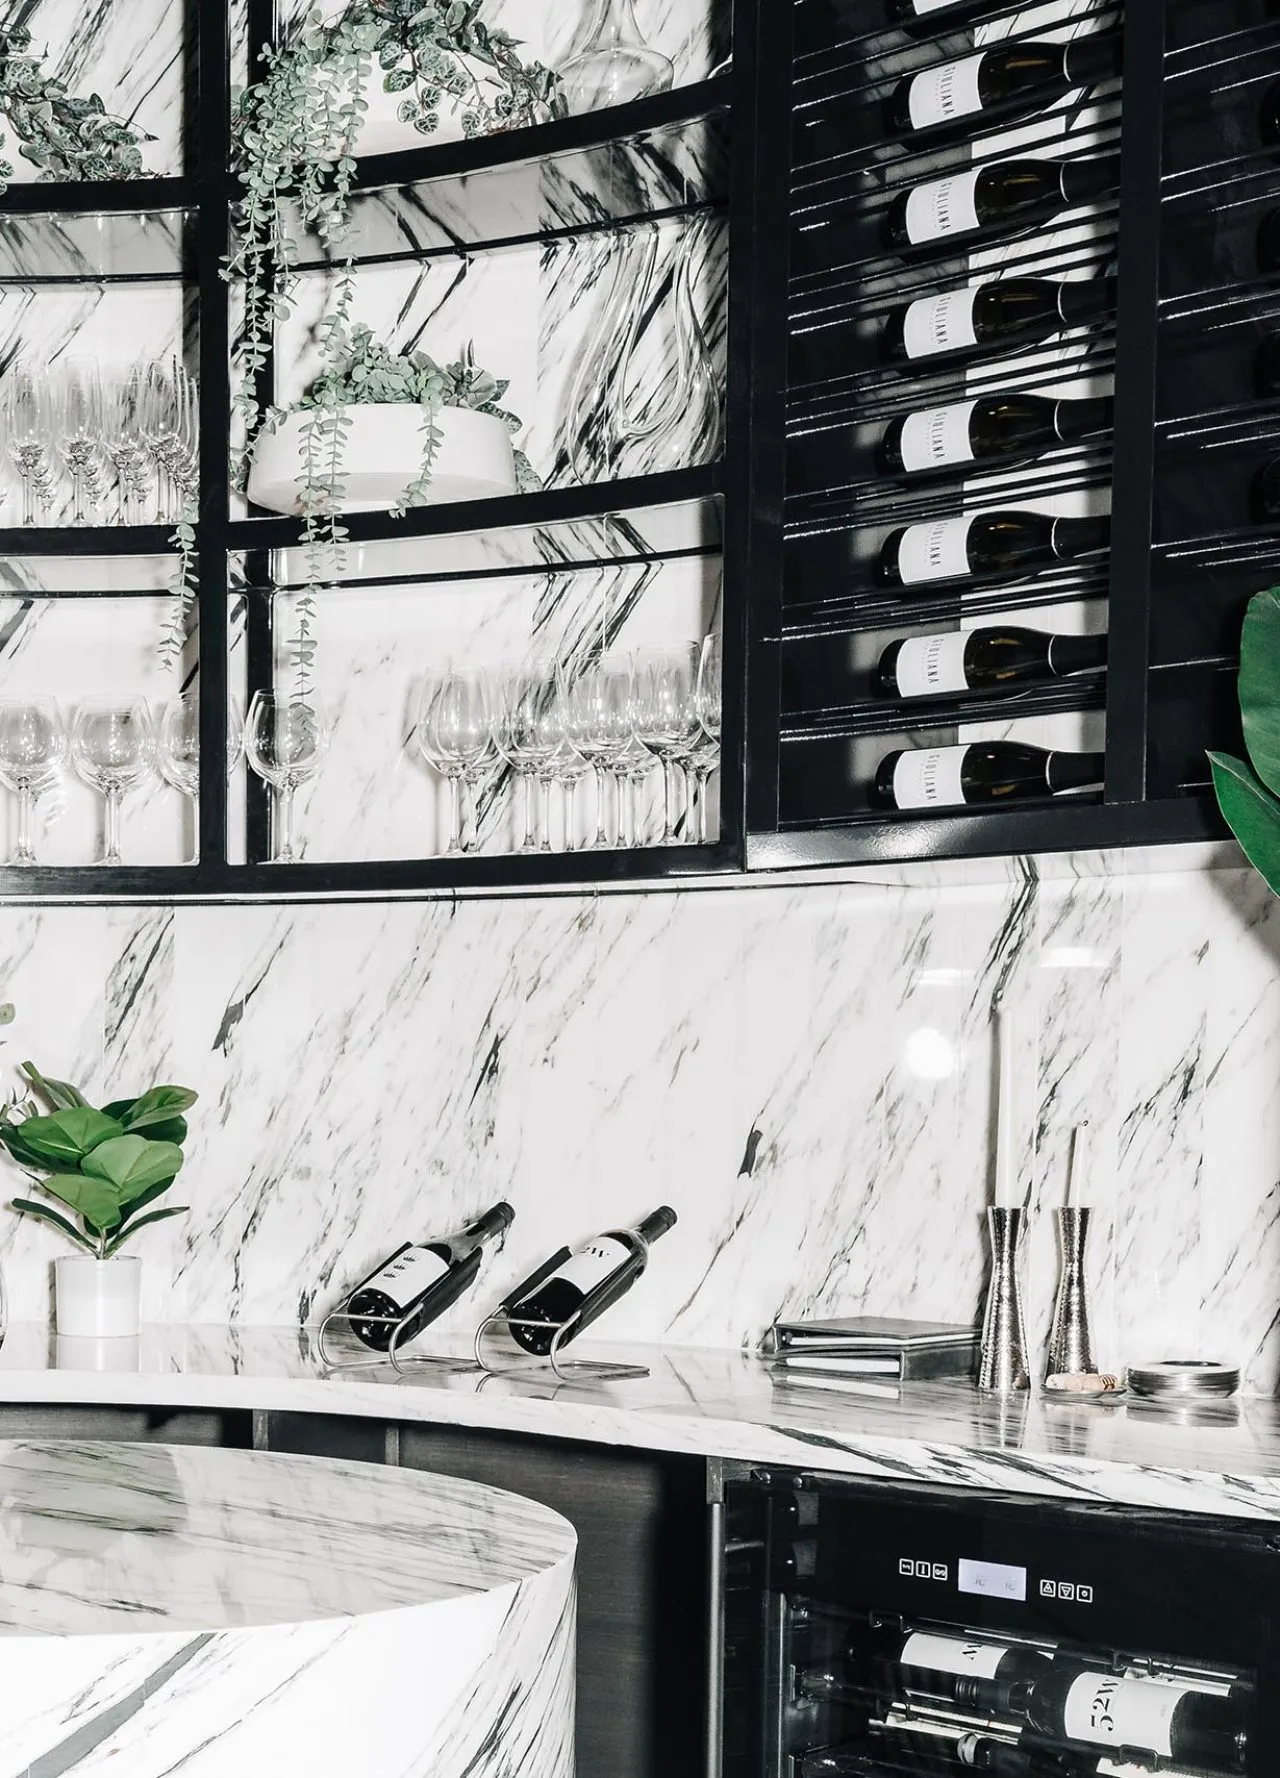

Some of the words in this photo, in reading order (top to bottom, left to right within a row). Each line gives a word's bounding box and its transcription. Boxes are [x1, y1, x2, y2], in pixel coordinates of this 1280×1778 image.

[940, 66, 956, 116] GIULIANA
[936, 182, 952, 231] GIULIANA
[935, 296, 952, 345] GIULIANA
[931, 412, 948, 459] GIULIANA
[929, 522, 948, 567] GIULIANA
[927, 638, 944, 684] GIULIANA
[924, 754, 941, 801] GIULIANA
